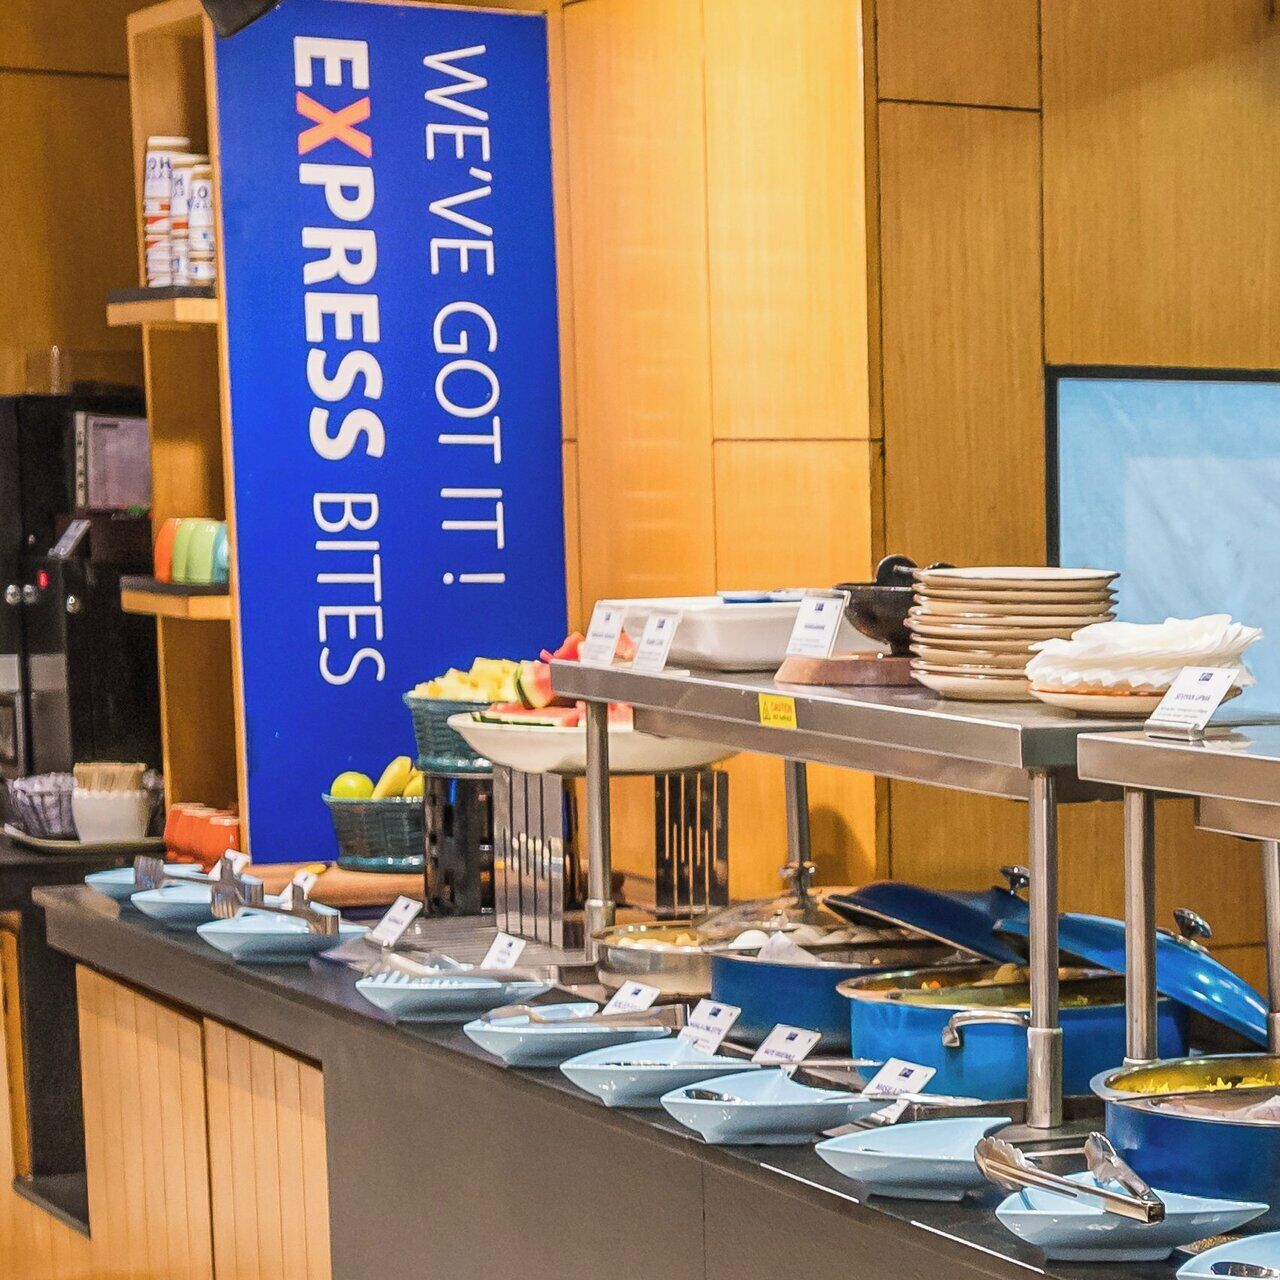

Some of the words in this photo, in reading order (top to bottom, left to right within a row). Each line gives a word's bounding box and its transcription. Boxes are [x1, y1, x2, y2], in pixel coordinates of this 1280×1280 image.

[293, 36, 386, 461] EXPRESS
[423, 45, 494, 276] WE'VE
[432, 301, 502, 465] GOT
[313, 492, 386, 686] BITES
